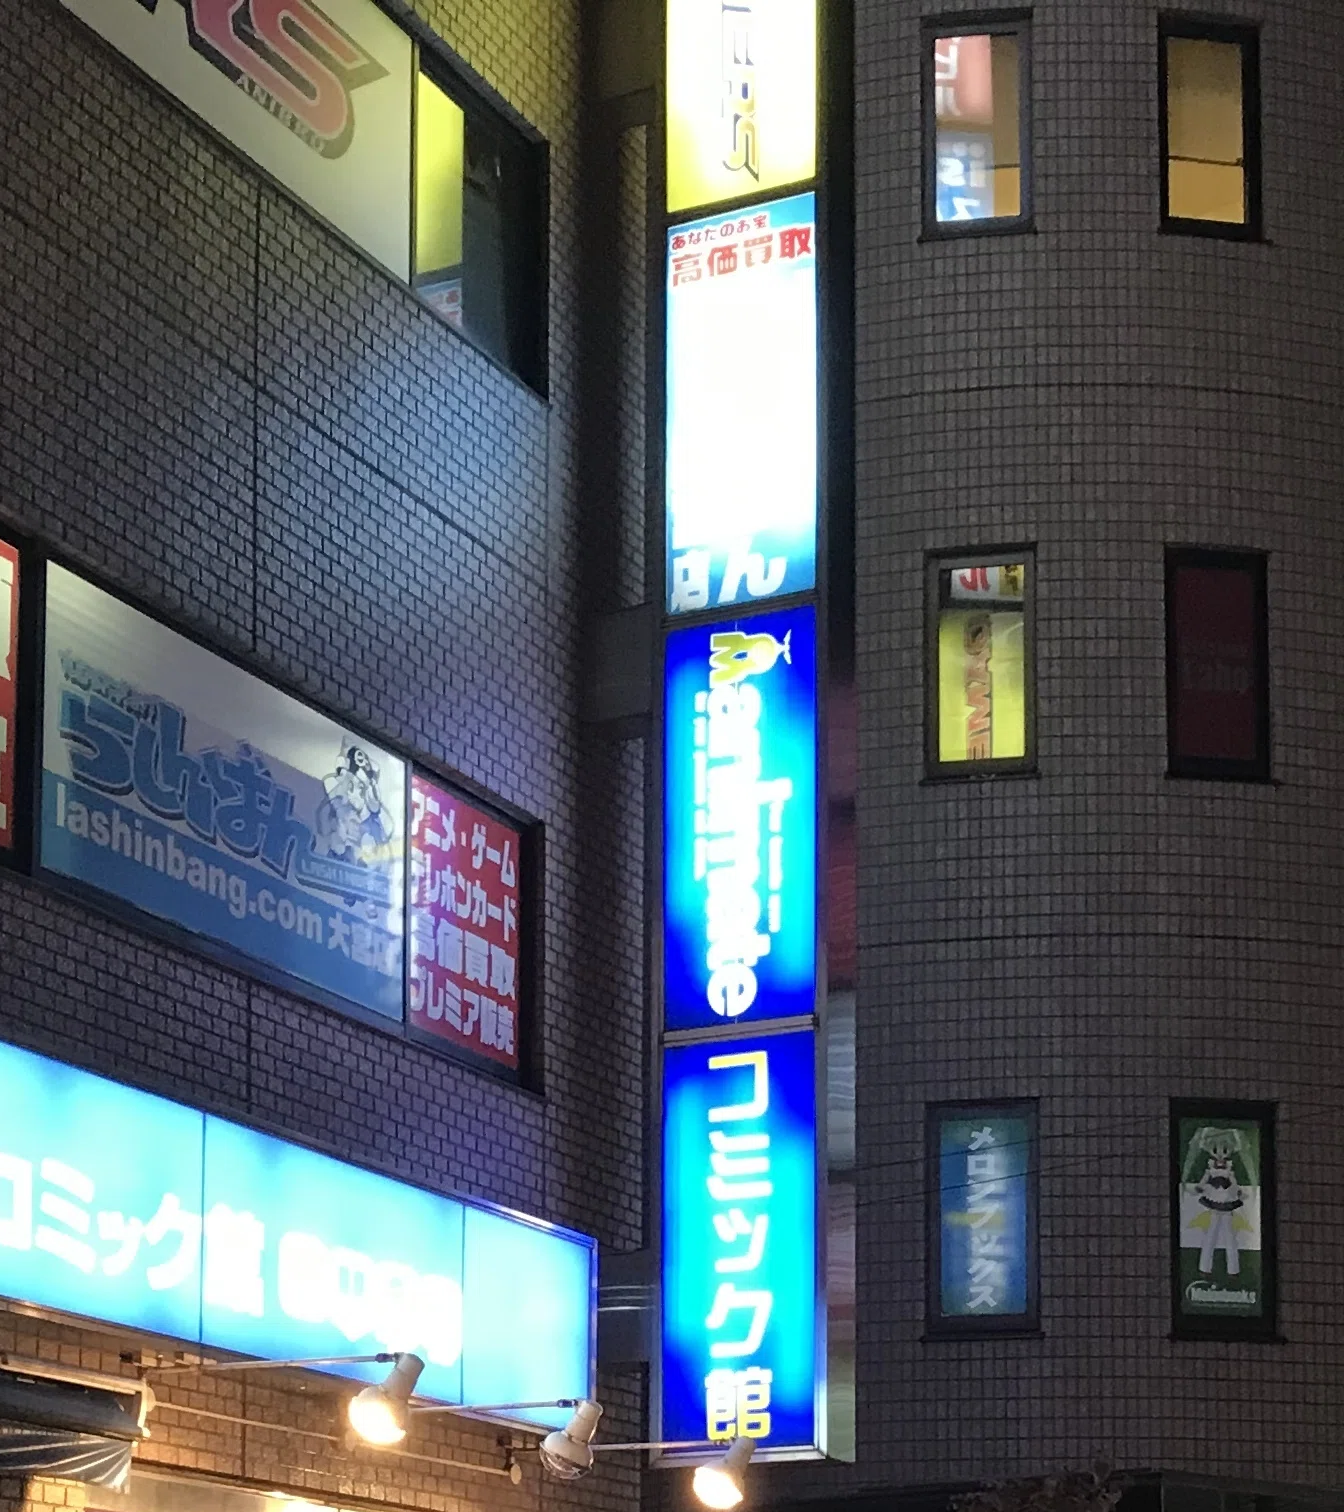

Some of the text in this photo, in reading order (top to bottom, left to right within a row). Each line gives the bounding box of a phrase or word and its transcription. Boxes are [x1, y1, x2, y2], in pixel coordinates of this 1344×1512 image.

[671, 214, 768, 251] あなたのお宝
[672, 226, 812, 287] 高価買取
[56, 782, 323, 943] lashinbang.com
[411, 786, 516, 888] アニメ・ゲーム
[706, 683, 793, 1018] animate
[411, 906, 516, 1000] 高価買取
[704, 1050, 772, 1440] コミック館
